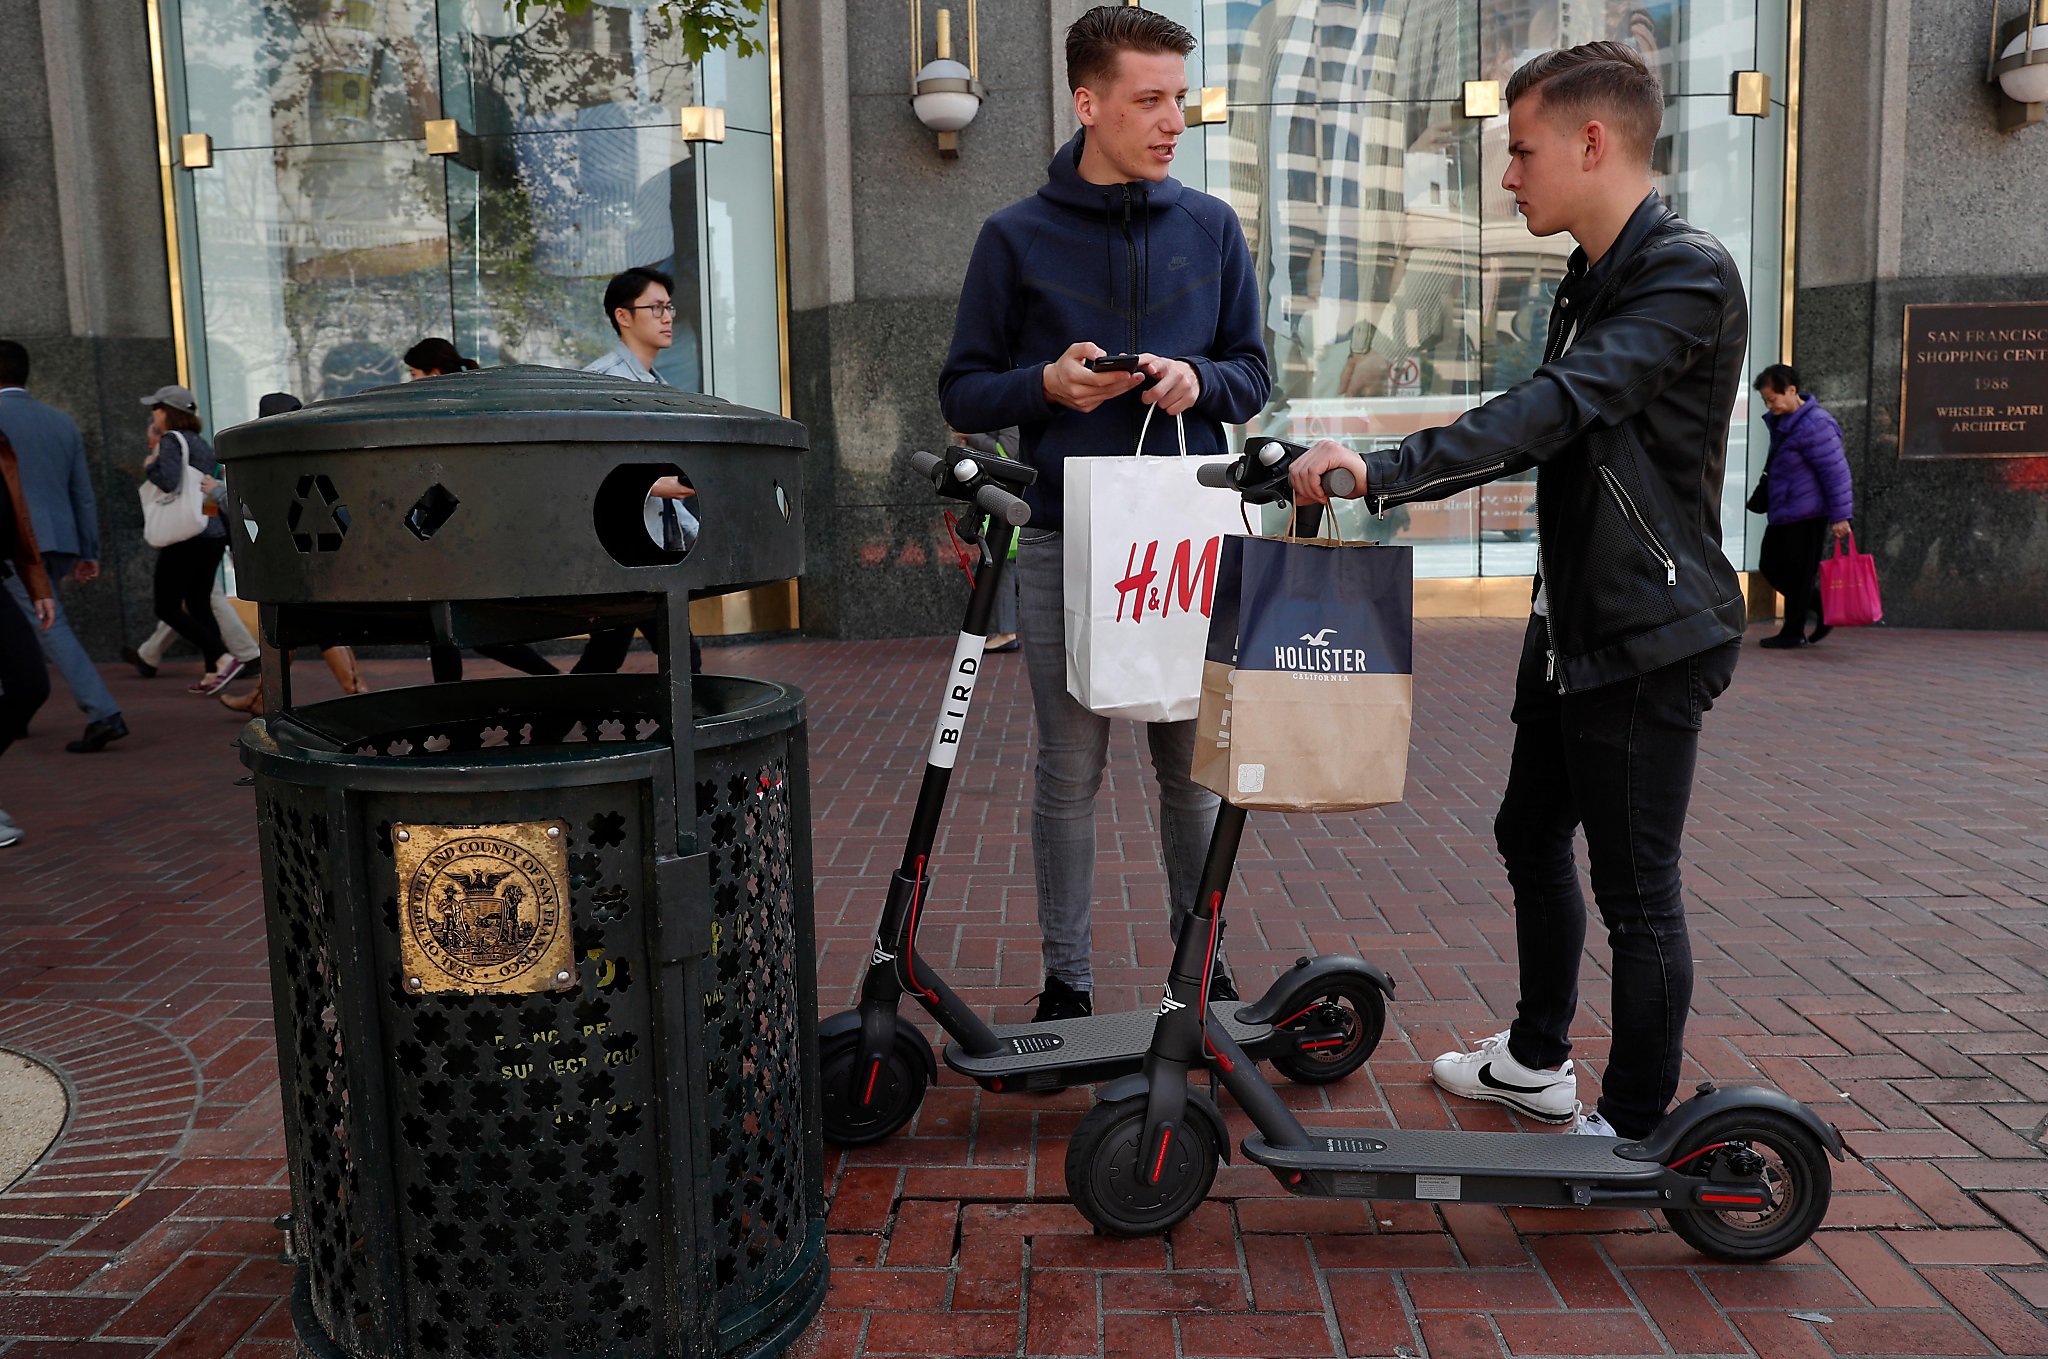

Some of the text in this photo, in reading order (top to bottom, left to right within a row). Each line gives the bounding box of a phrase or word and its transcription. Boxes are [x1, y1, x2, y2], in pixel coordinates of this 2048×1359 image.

[1927, 331, 1960, 343] SAN
[1916, 350, 1998, 364] SHOPPING
[1975, 377, 2009, 390] 1988
[1936, 406, 1995, 417] WHISLER
[2006, 405, 2044, 416] PATRI
[1952, 421, 2027, 432] ARCHITECT
[1114, 535, 1220, 624] H&M
[1274, 646, 1367, 672] HOLLISTER
[1292, 673, 1350, 682] CALIFORNIA
[939, 657, 978, 744] BIRD
[429, 847, 456, 871] AND
[458, 841, 522, 861] COUNTY
[522, 859, 540, 875] OF
[414, 870, 430, 900] CITY
[536, 877, 554, 906] SAN
[414, 905, 426, 935] THE
[422, 939, 439, 956] OF
[500, 909, 554, 977] FRANCISCO
[441, 958, 475, 978] SEAL
